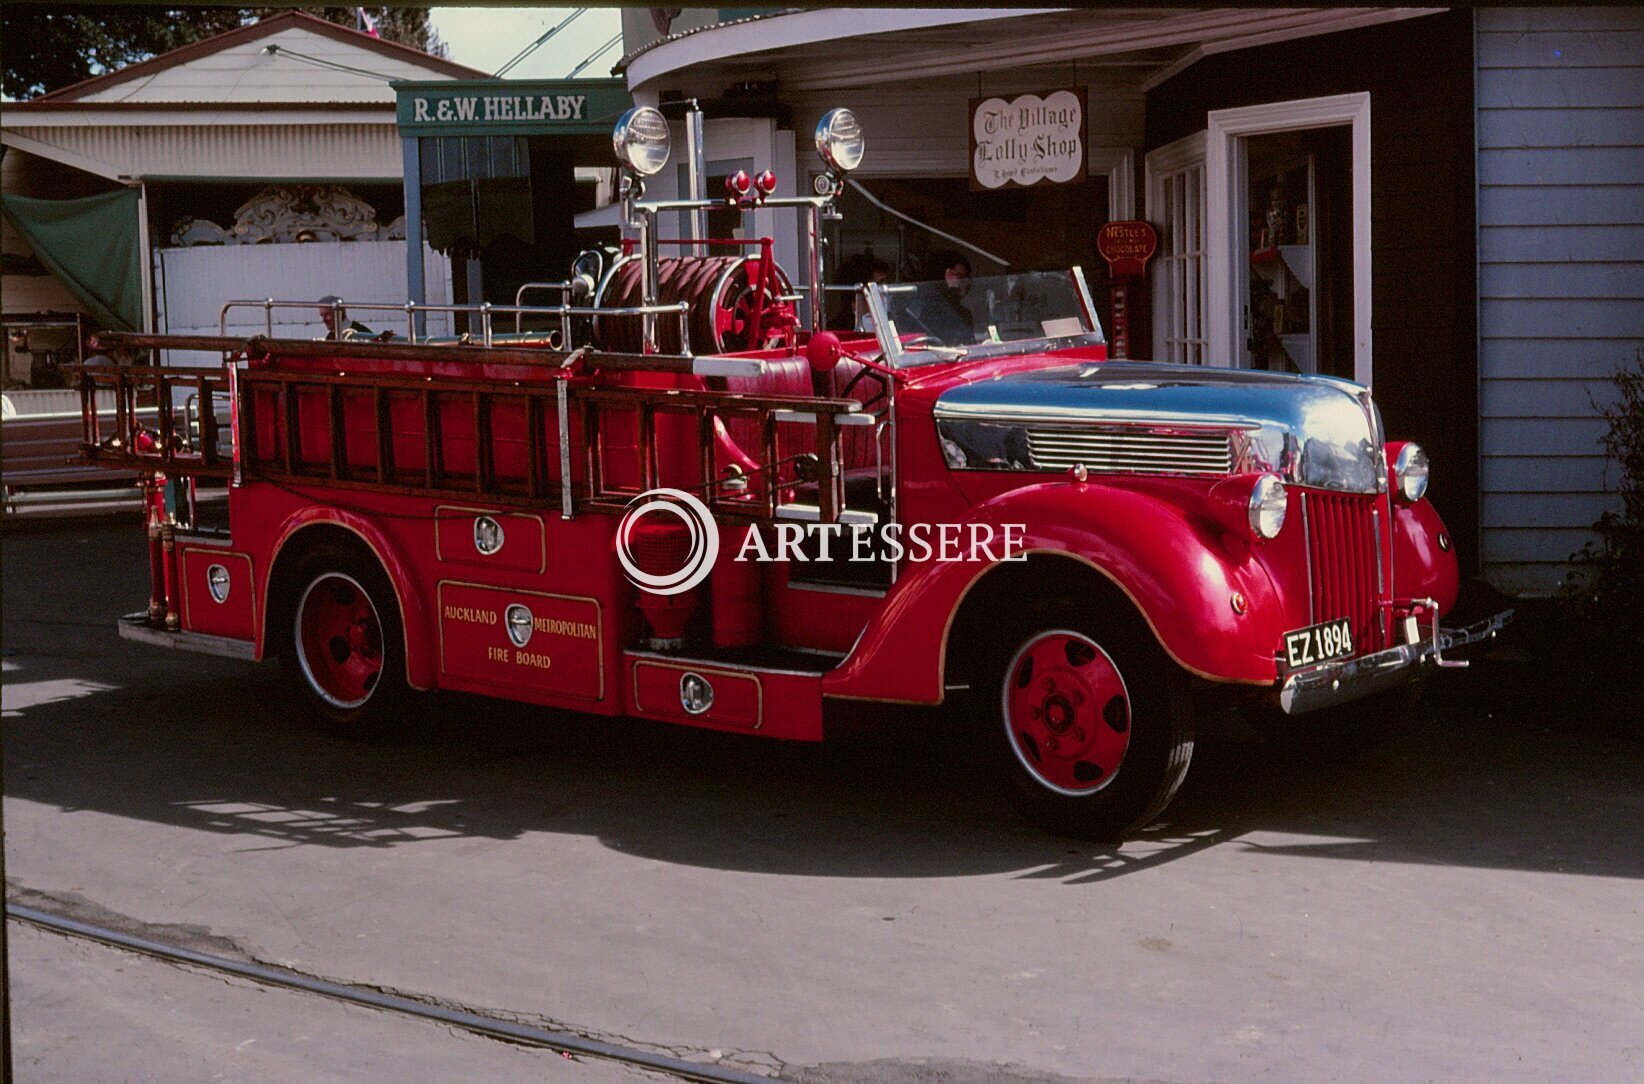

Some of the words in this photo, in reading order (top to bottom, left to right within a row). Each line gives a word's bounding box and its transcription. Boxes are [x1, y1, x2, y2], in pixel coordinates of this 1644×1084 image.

[484, 95, 585, 119] HELLABY
[983, 109, 1014, 134] The
[1018, 107, 1076, 135] Village
[978, 138, 1028, 166] Lolly
[1031, 135, 1077, 163] Shop
[1105, 244, 1148, 255] CHOCOLATE
[444, 605, 497, 625] AUCKLAND
[534, 616, 597, 639] METROPOLITAN
[488, 646, 509, 663] FIRE
[516, 651, 551, 669] BOARD
[1286, 632, 1315, 667] EZ
[1315, 621, 1352, 659] 1894
